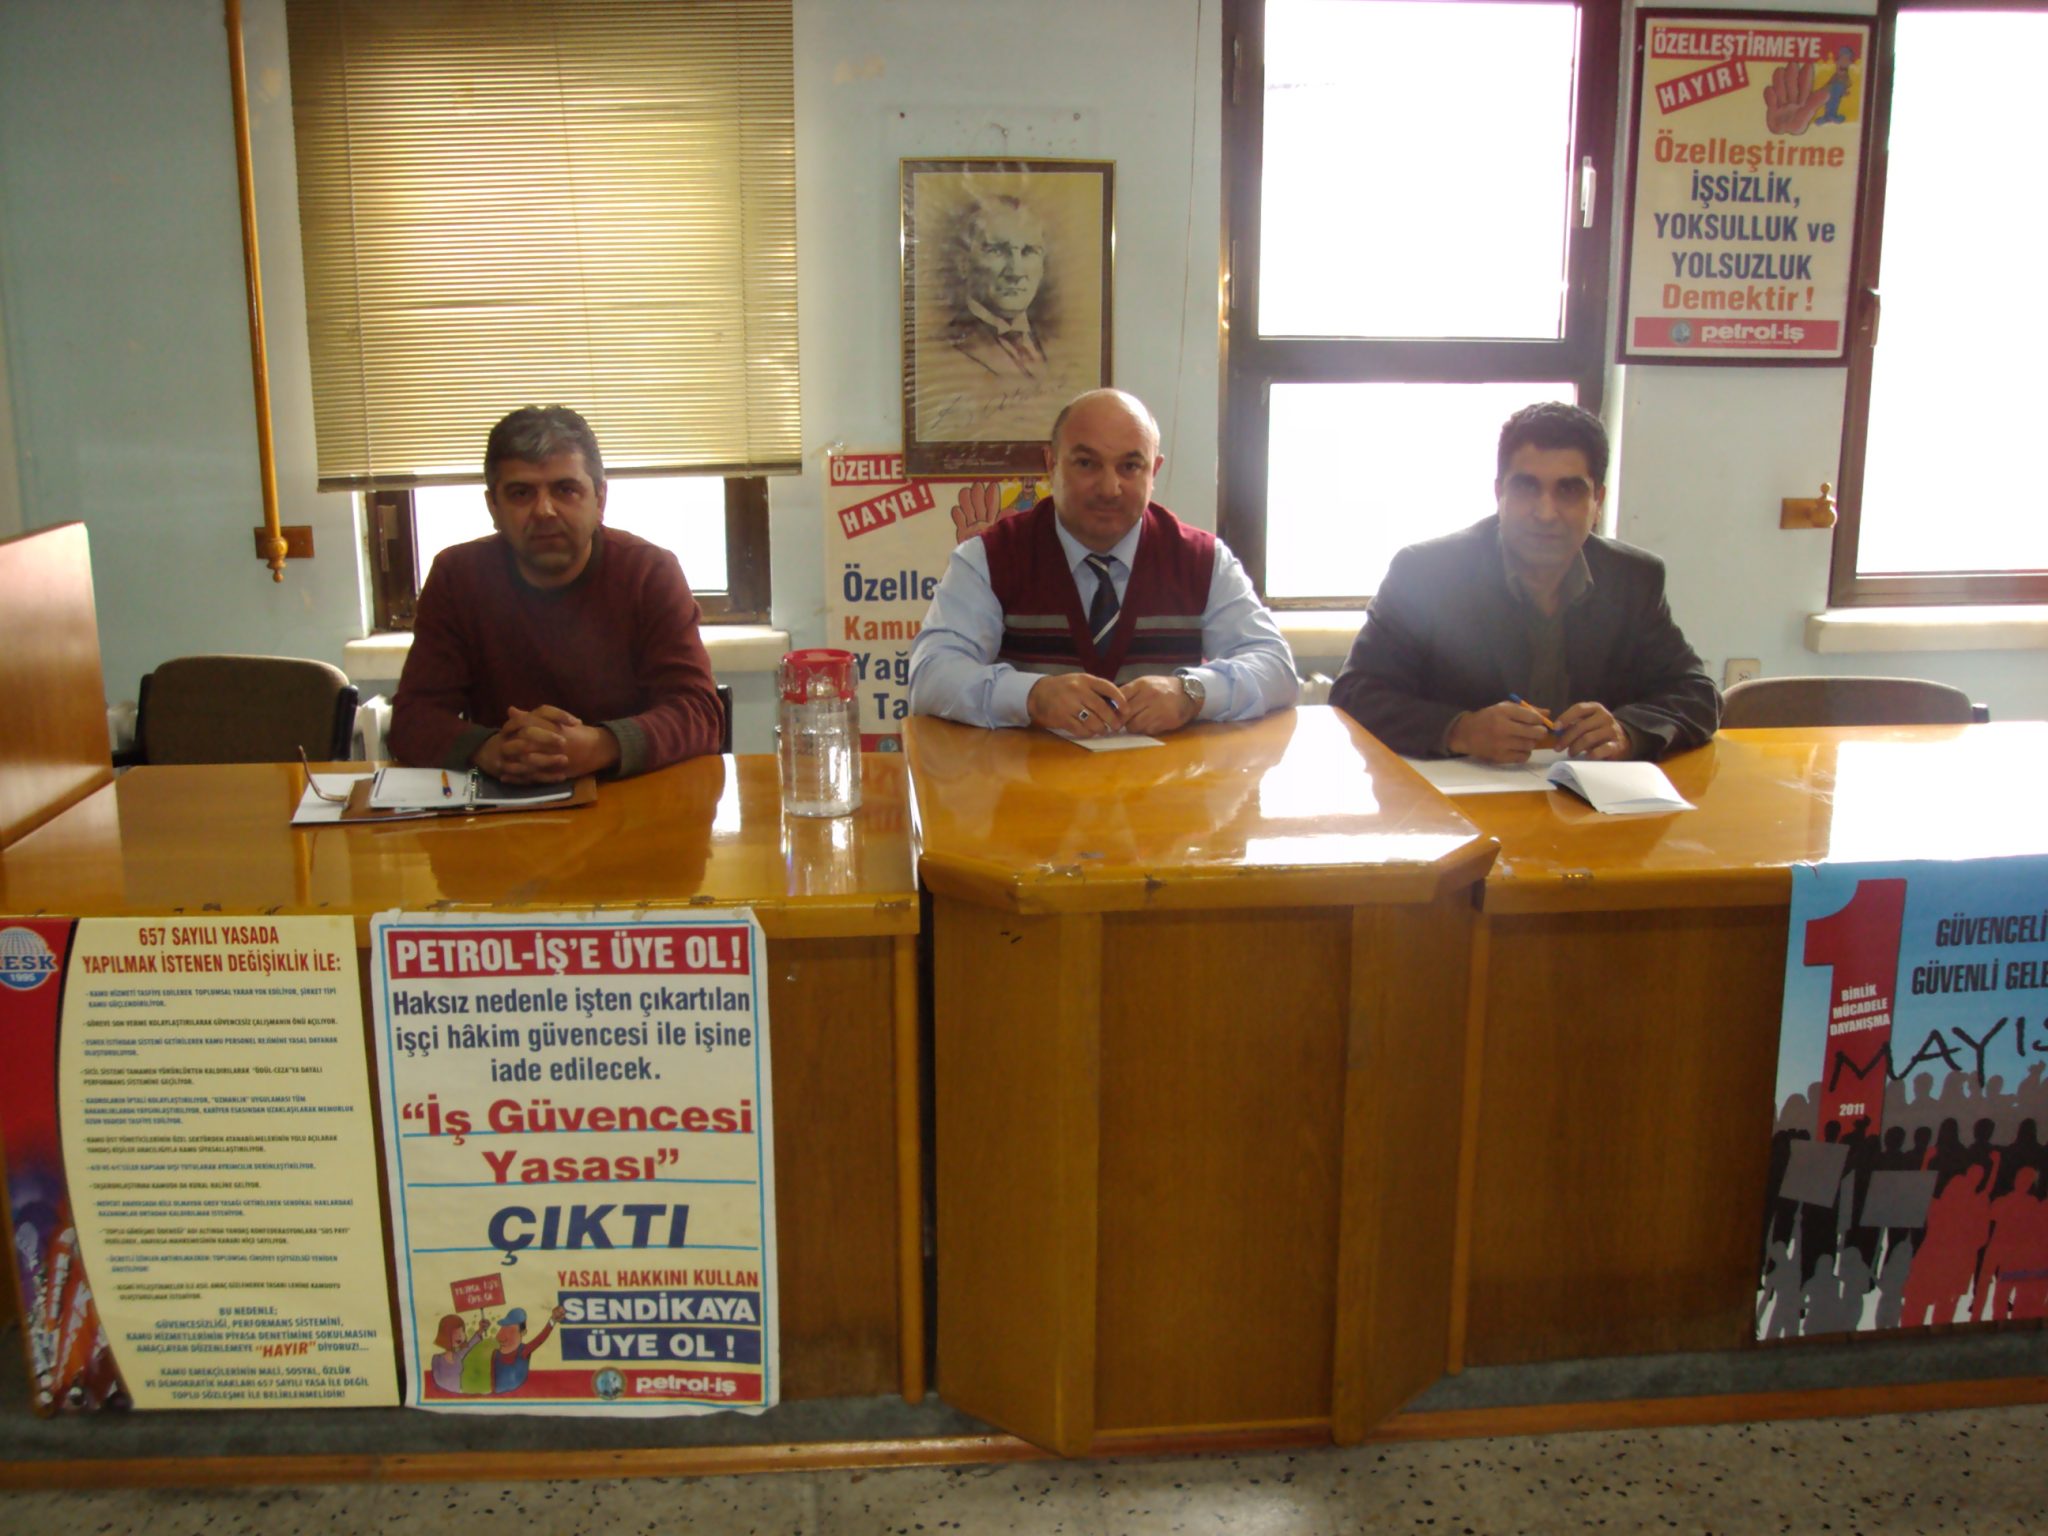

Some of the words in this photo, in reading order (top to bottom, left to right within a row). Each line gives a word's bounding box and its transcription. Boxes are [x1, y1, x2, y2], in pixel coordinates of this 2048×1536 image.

[1654, 28, 1822, 60] ÖZELLEŞTİRMEYE
[1654, 129, 1845, 173] Özelleştirme
[1691, 170, 1800, 209] İŞSİZLİK,
[1654, 213, 1798, 242] YOKSULLUK
[1808, 222, 1836, 243] ve
[1671, 252, 1813, 281] YOLSUZLUK
[1701, 323, 1805, 344] petrol-iş
[832, 456, 903, 482] ÖZELLE
[843, 563, 941, 602] Özelle
[139, 927, 166, 946] 657
[172, 927, 217, 946] SAYILI
[222, 926, 279, 945] YASADA
[1935, 909, 2048, 948] GÜVENCELİ
[0, 956, 56, 970] ESK
[82, 955, 156, 974] YAPILMAK
[160, 953, 224, 974] İSTENEN
[229, 950, 309, 976] DEĞİŞİKLİK
[313, 949, 341, 972] İLE:
[611, 934, 674, 969] ÜYE
[1912, 957, 1999, 995] GÜVENLİ
[394, 988, 470, 1016] Haksız
[476, 988, 568, 1014] nedenle
[574, 987, 633, 1018] işten
[640, 986, 751, 1018] çıkartılan
[1841, 984, 1878, 1002] BİRLİK
[1832, 998, 1888, 1020] MÜCADELE
[396, 1026, 440, 1058] işçi
[447, 1023, 521, 1049] hâkim
[528, 1022, 649, 1053] güvencesi
[657, 1022, 688, 1046] ile
[694, 1021, 752, 1053] işine
[1830, 1013, 1891, 1037] DAYANIŞMA
[491, 1058, 542, 1083] iade
[549, 1056, 662, 1082] edilecek.
[487, 1098, 752, 1135] Güvencesi
[1839, 1103, 1865, 1117] 2011
[487, 1204, 690, 1266] ÇIKTI
[558, 1269, 612, 1289] YASAL
[617, 1269, 688, 1288] HAKKINI
[693, 1270, 759, 1288] KULLAN
[219, 1307, 232, 1316] BU
[565, 1292, 757, 1323] SENDİKAYA
[255, 1341, 317, 1358] "HAYIR"
[587, 1329, 659, 1359] ÜYE
[636, 1374, 737, 1397] petrol-iş
